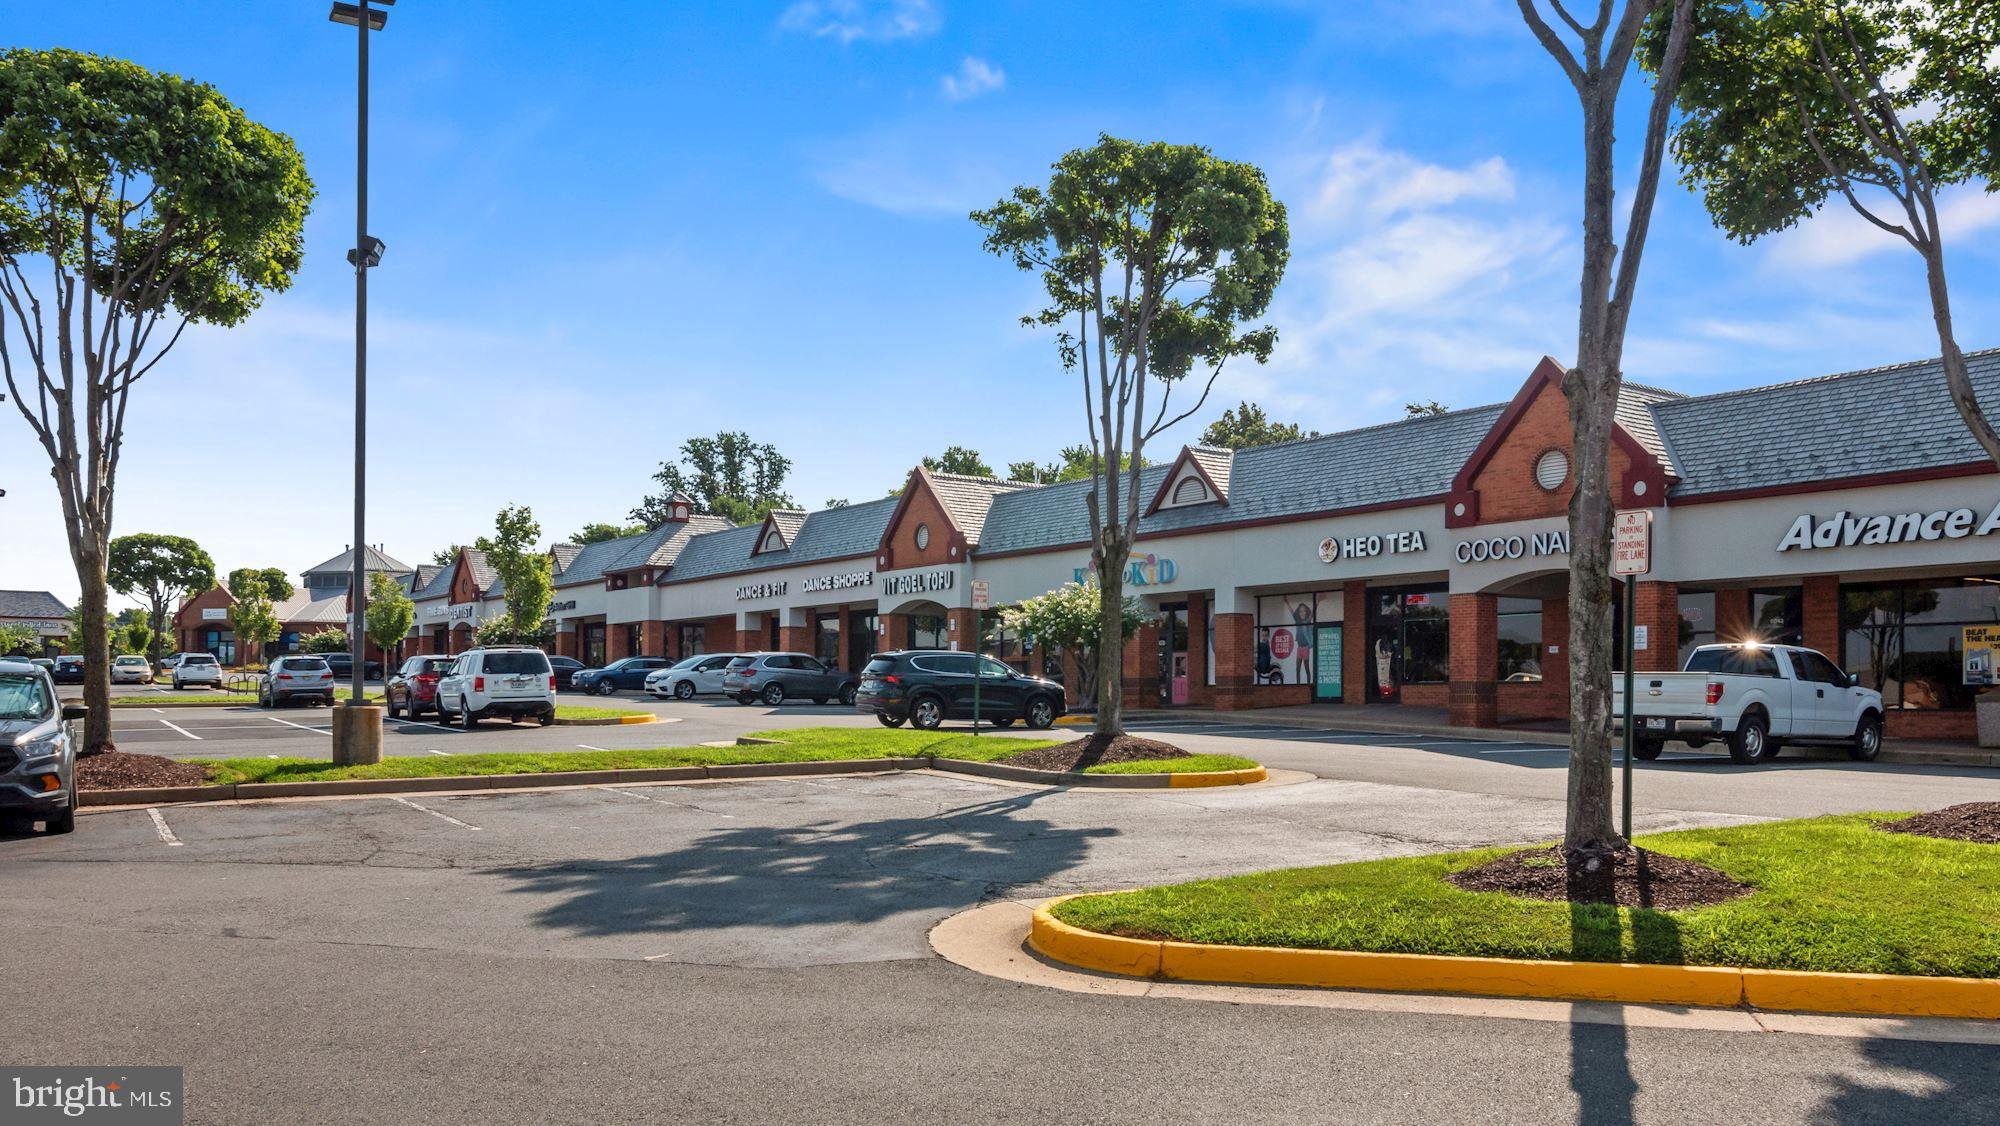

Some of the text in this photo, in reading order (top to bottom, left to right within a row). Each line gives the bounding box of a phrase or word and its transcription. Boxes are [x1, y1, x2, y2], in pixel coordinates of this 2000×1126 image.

[1619, 525, 1643, 535] PARKING
[1776, 508, 1974, 552] Advance
[1343, 530, 1424, 559] HEO TEA
[1455, 535, 1524, 564] COCO
[1617, 549, 1645, 560] FIRE LANE
[1618, 540, 1644, 549] STANDING
[735, 581, 787, 600] DANCE & FIT
[803, 571, 872, 592] DANCE SHOPPE
[899, 575, 926, 593] GOEL
[926, 571, 953, 591] TOFU
